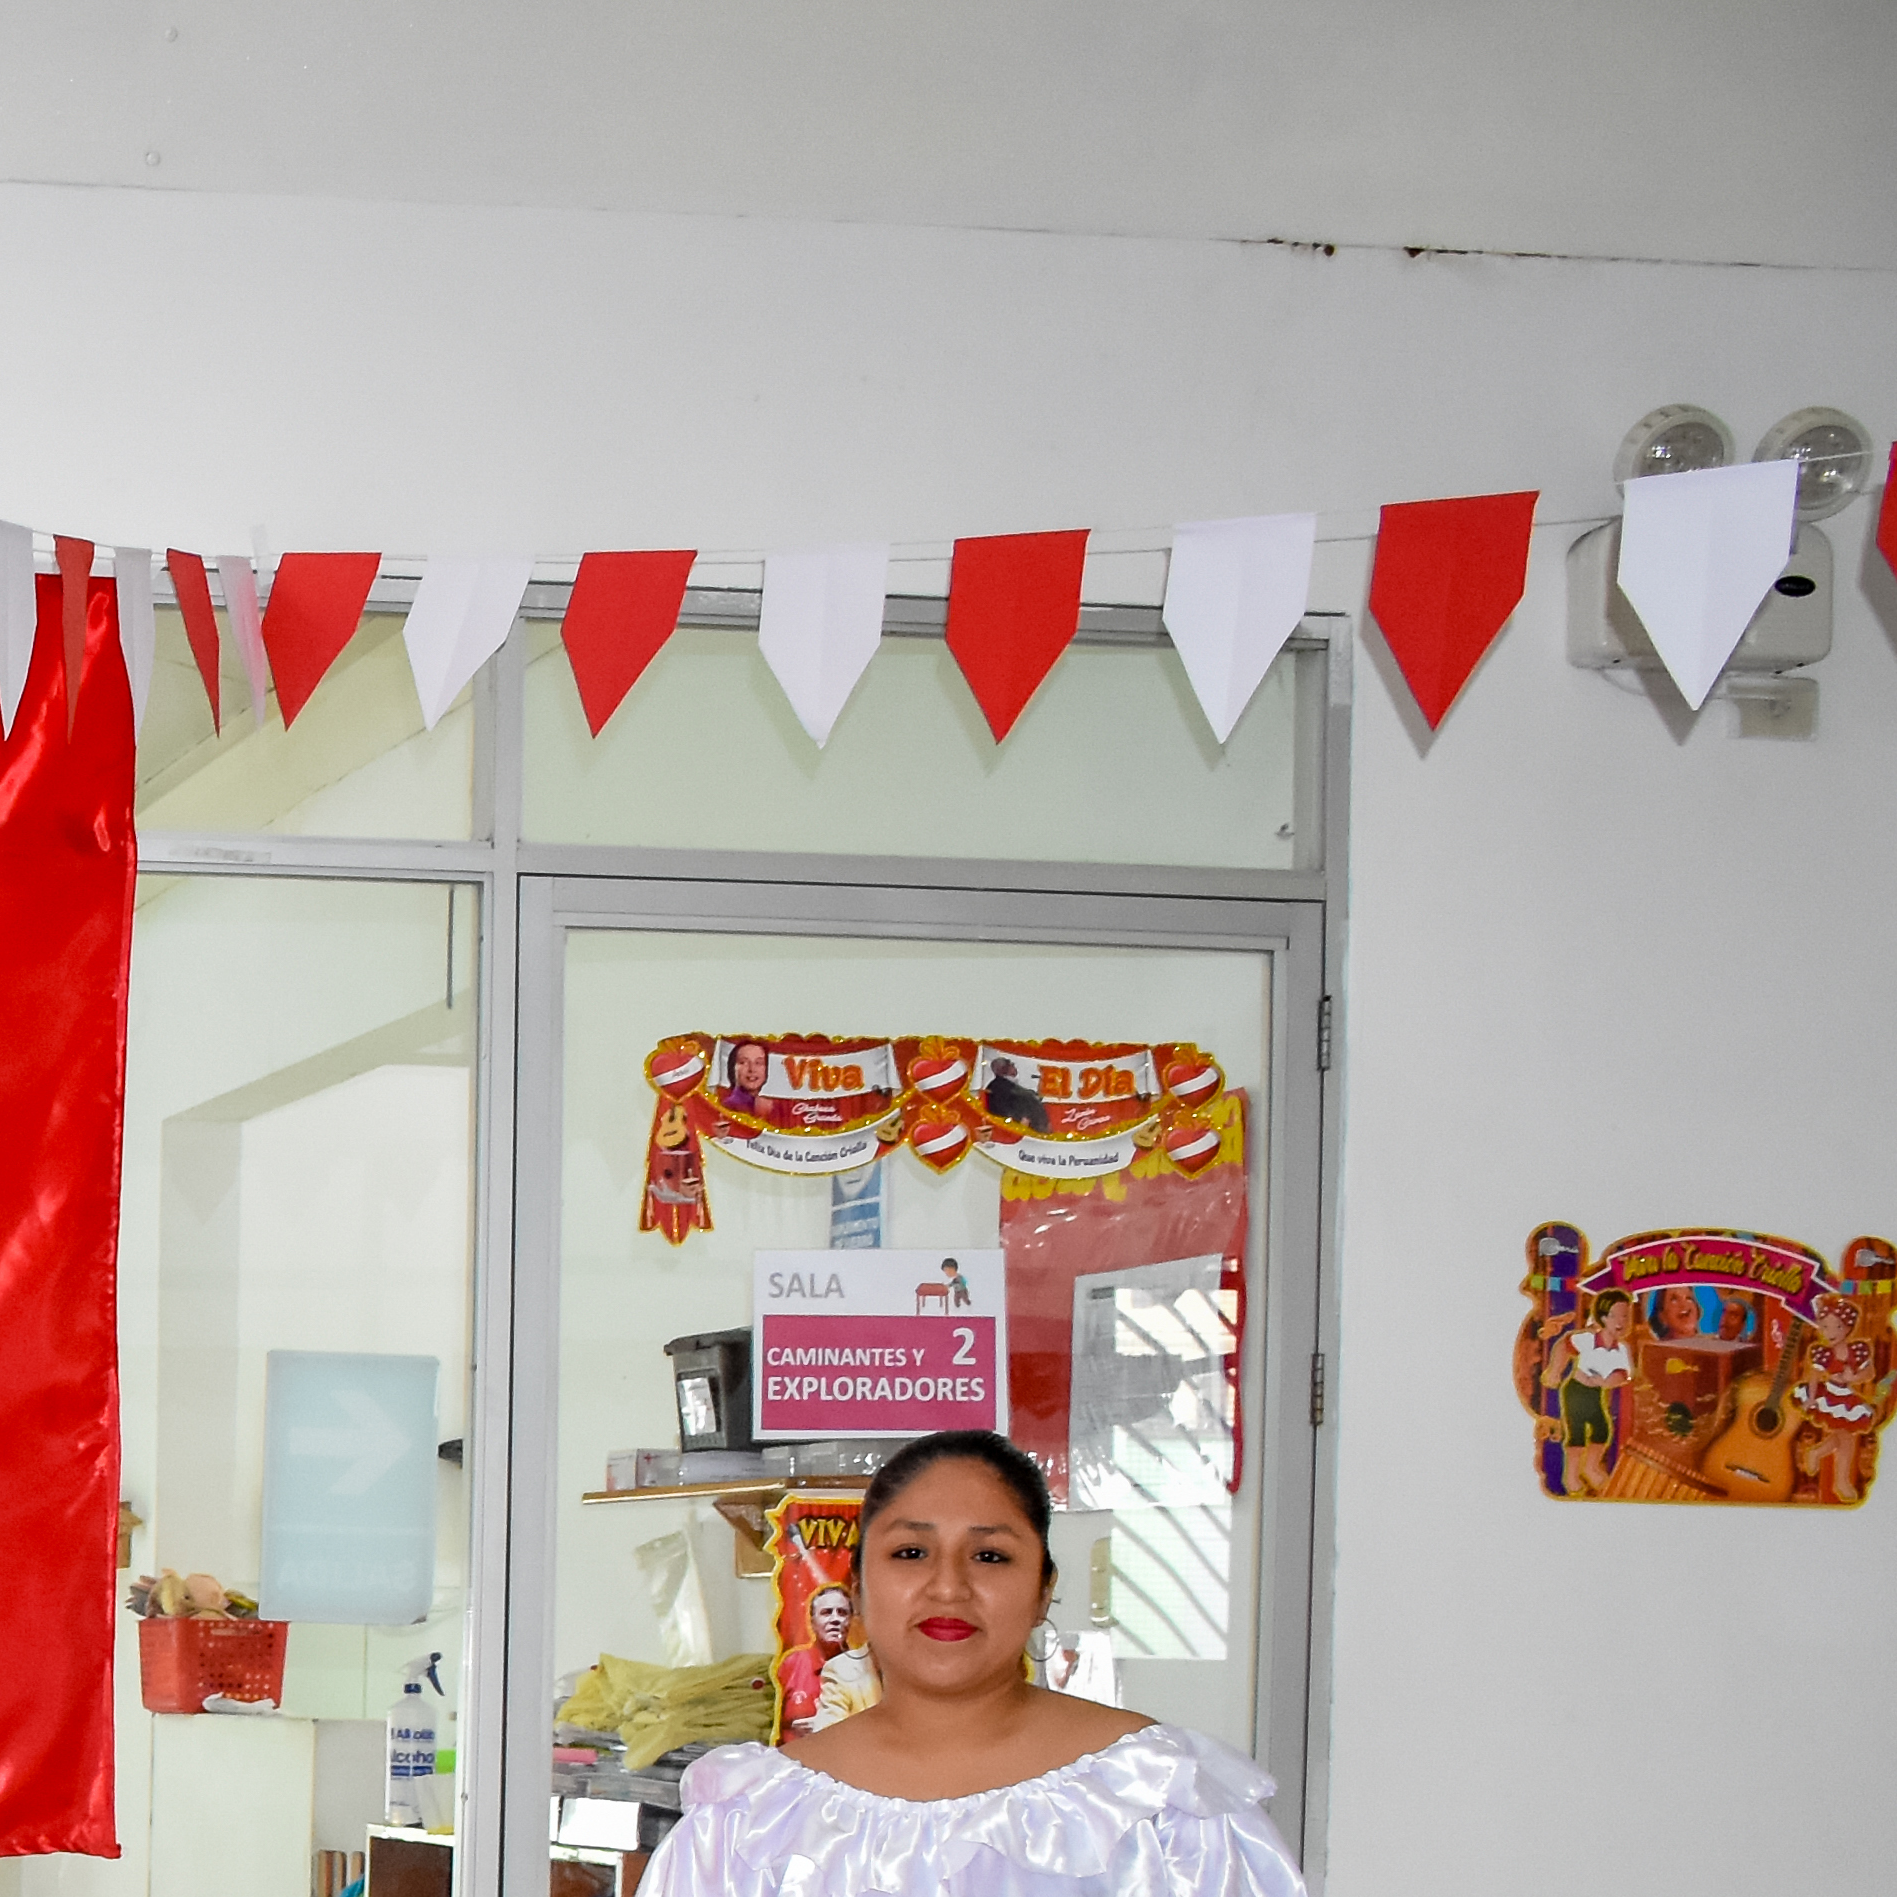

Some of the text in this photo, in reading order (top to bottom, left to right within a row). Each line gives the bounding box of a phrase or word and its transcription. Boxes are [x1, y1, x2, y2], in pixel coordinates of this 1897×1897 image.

[781, 1055, 865, 1092] Viva
[1038, 1064, 1072, 1099] El
[1019, 1149, 1036, 1163] Que
[1037, 1154, 1056, 1166] viva
[1058, 1154, 1066, 1166] la
[768, 1272, 845, 1299] SALA
[767, 1327, 976, 1367] CAMINANTES Y 2
[767, 1376, 985, 1402] EXPLORADORES
